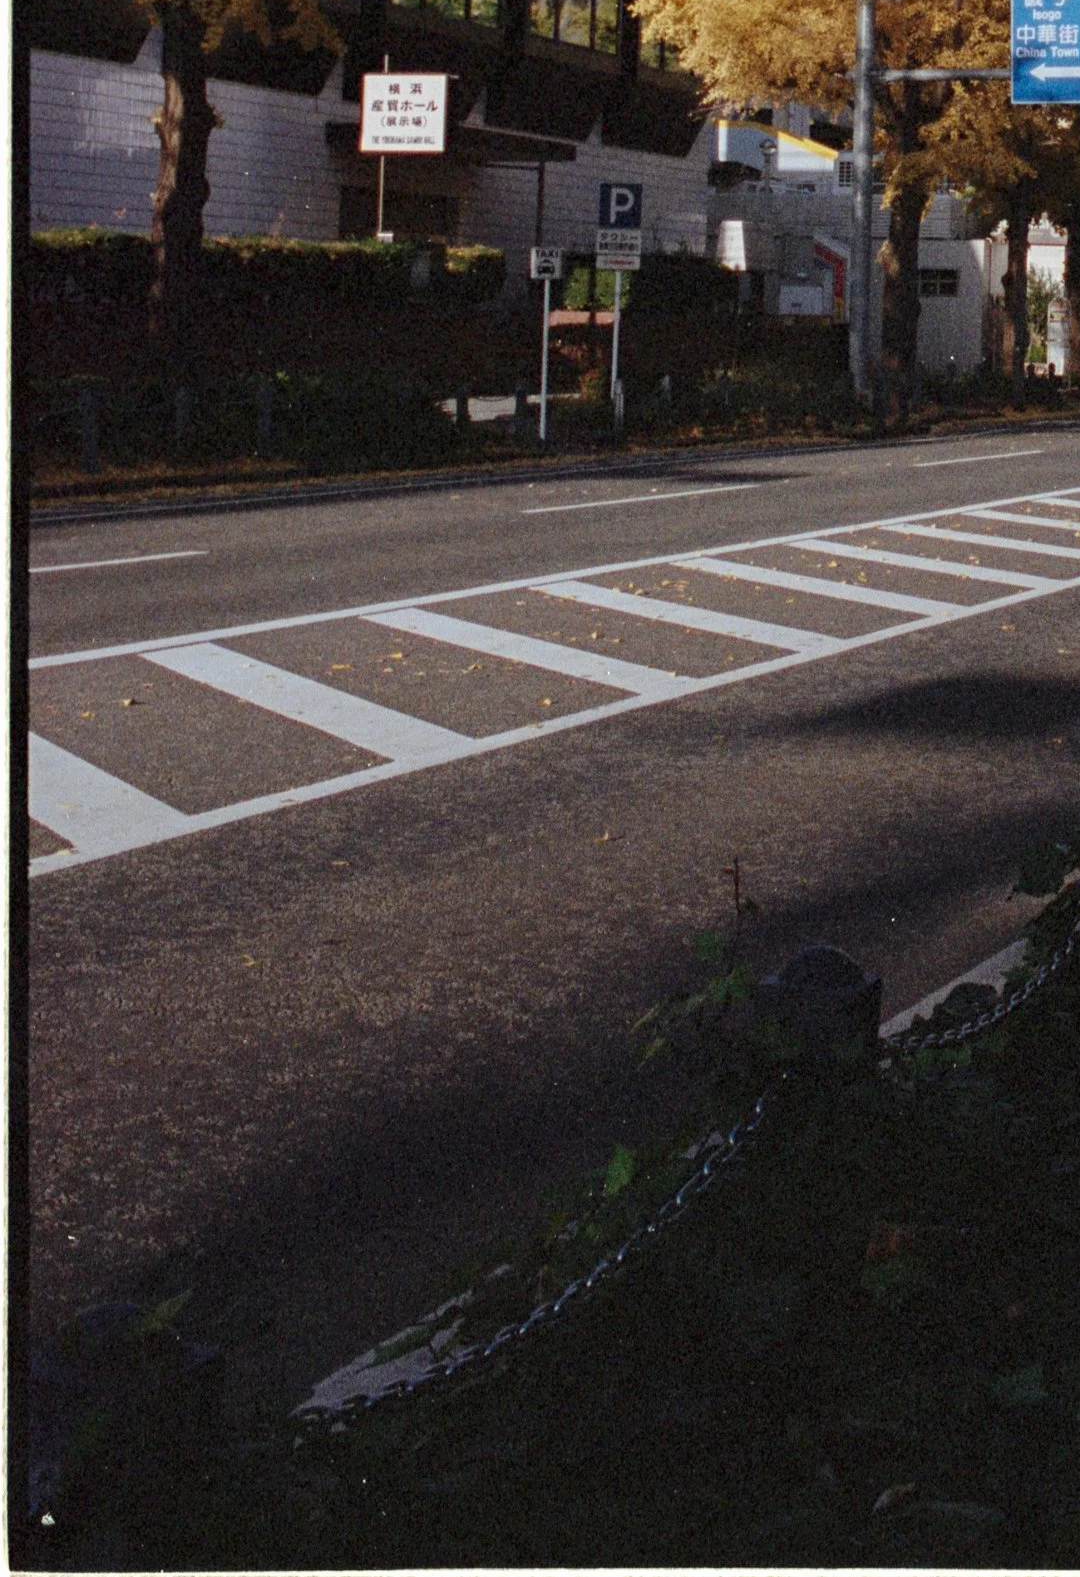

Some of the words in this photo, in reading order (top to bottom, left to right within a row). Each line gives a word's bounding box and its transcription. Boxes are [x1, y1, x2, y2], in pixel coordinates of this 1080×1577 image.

[1032, 10, 1062, 21] Isogo
[1016, 24, 1080, 45] 中華街
[1015, 47, 1047, 58] China
[1050, 46, 1080, 57] Town
[388, 82, 423, 95] 横浜
[609, 186, 636, 224] P
[536, 249, 559, 258] TAXI
